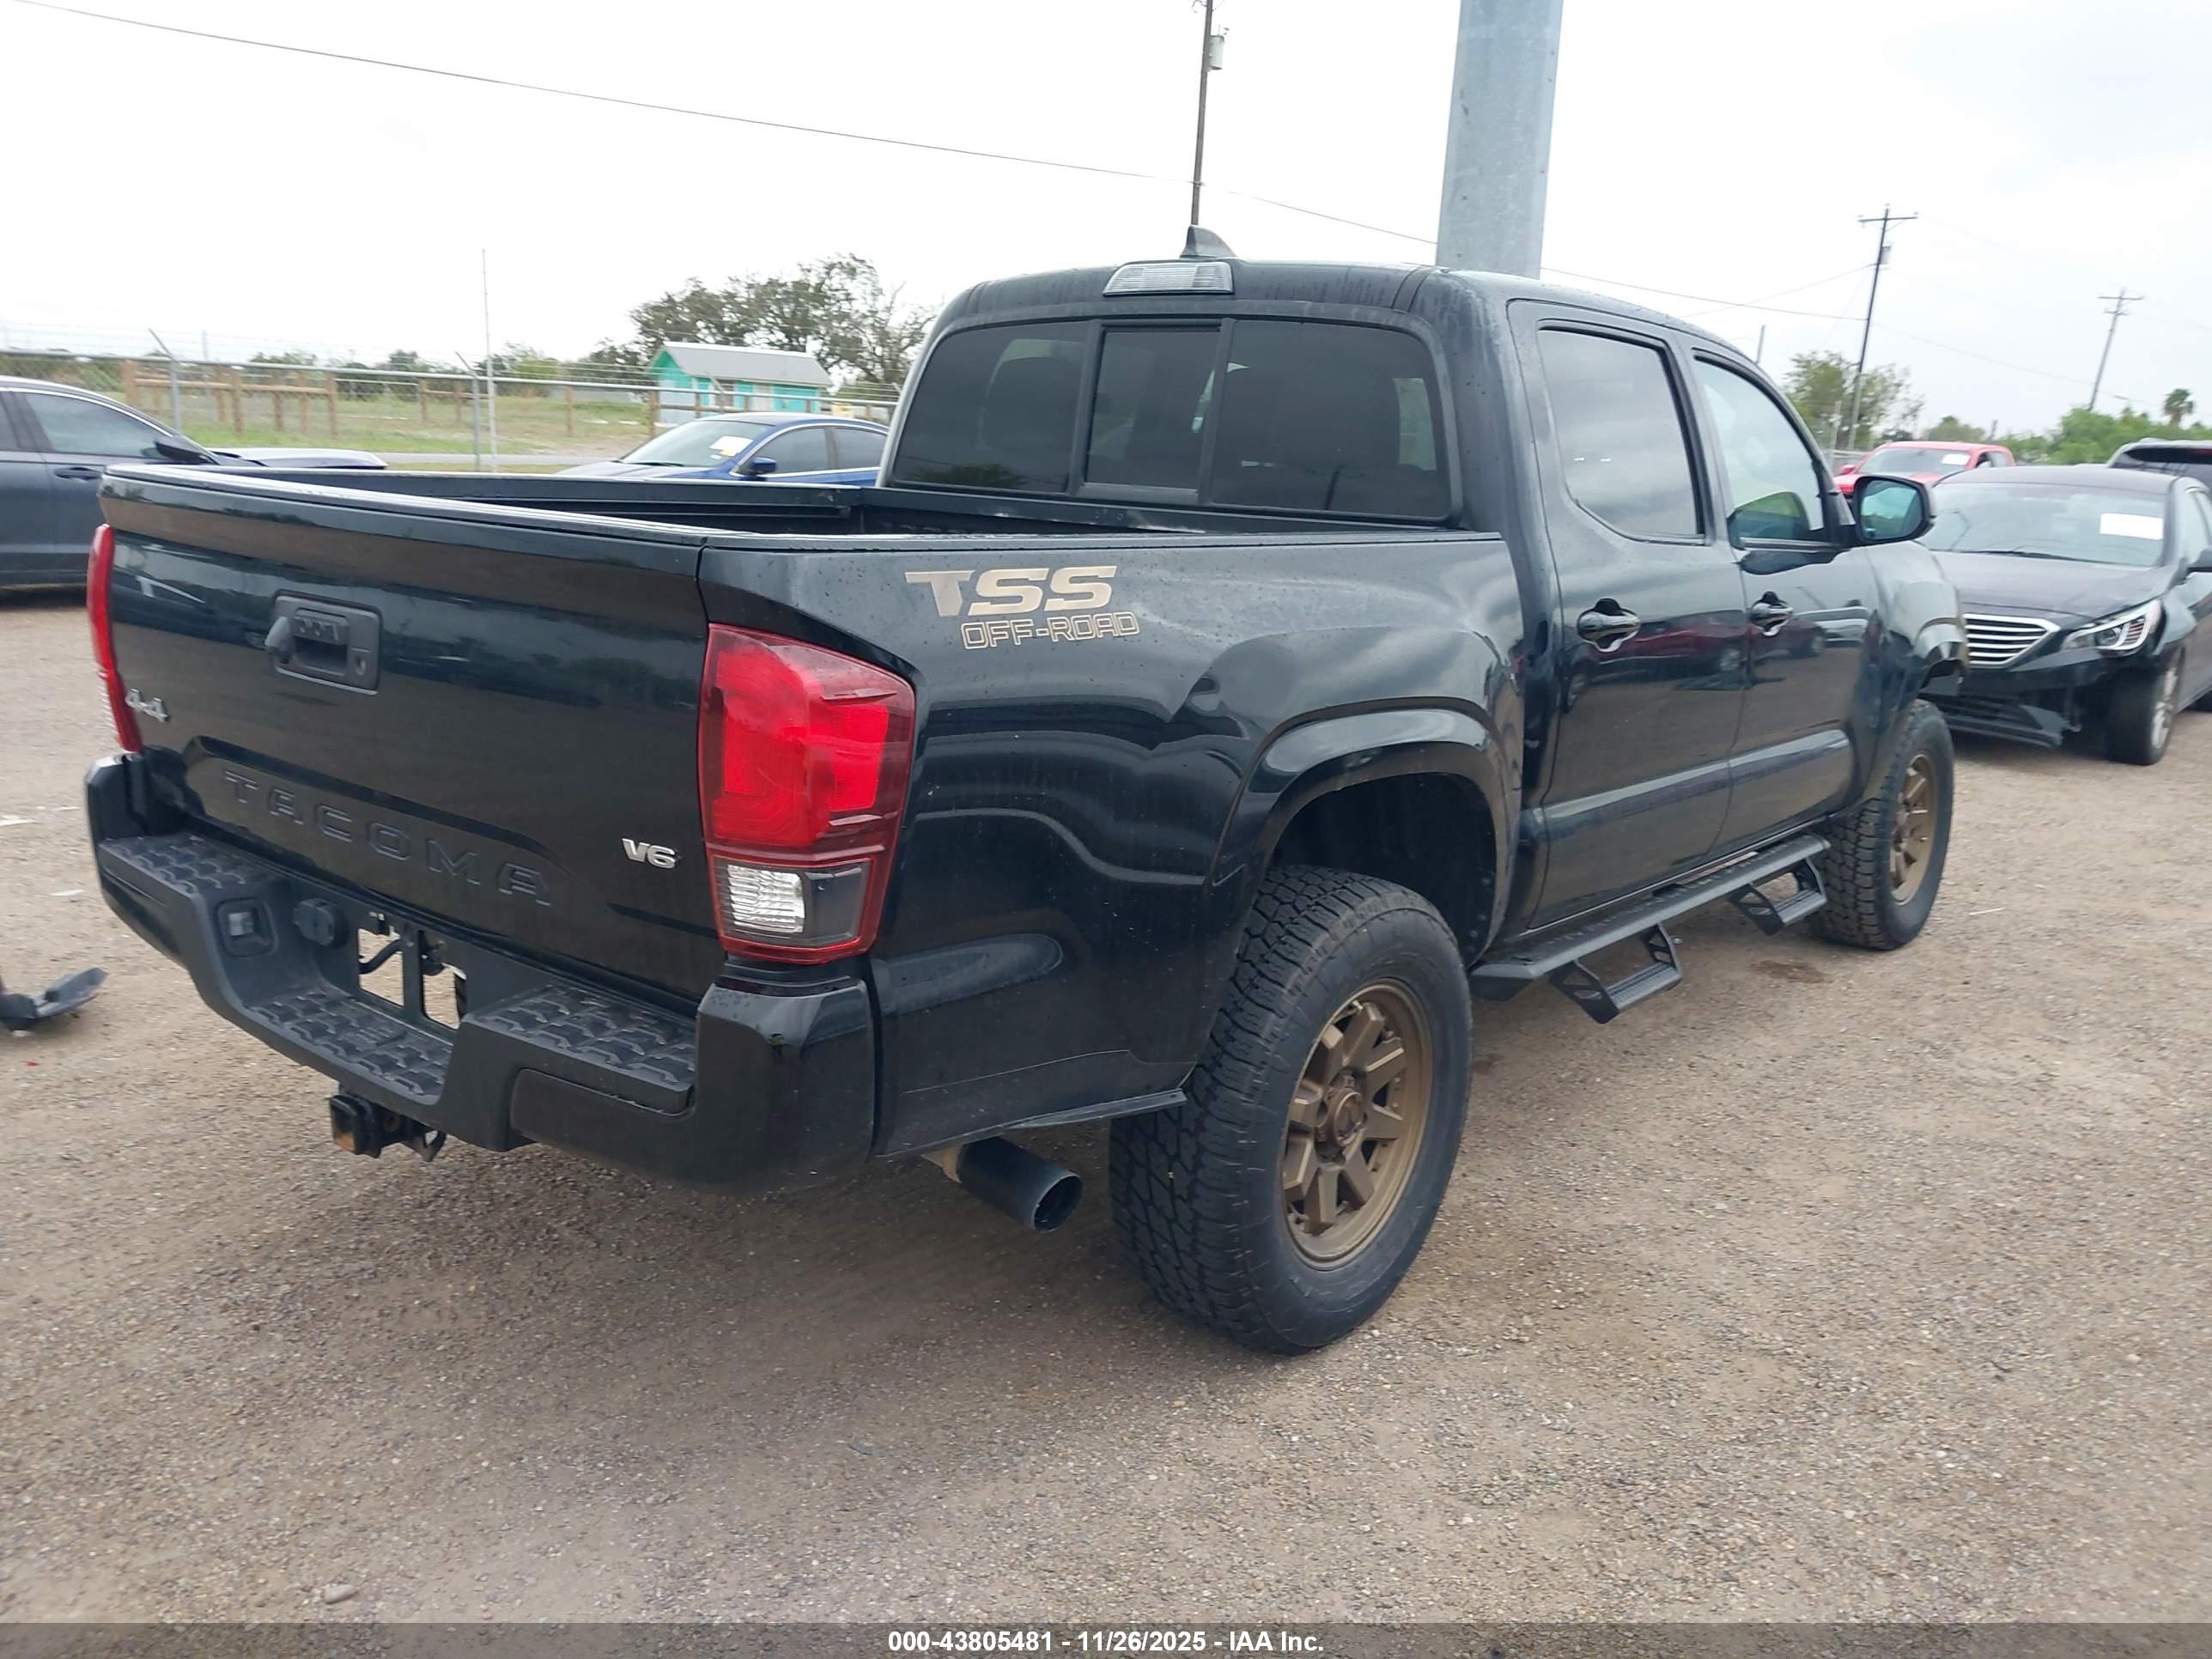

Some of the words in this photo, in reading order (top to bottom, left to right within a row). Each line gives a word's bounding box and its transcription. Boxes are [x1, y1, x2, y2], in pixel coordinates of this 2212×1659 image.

[904, 565, 1117, 617] TSS
[960, 611, 1140, 650] OFF-ROAD
[223, 769, 551, 907] TACOMA
[621, 837, 676, 869] V6
